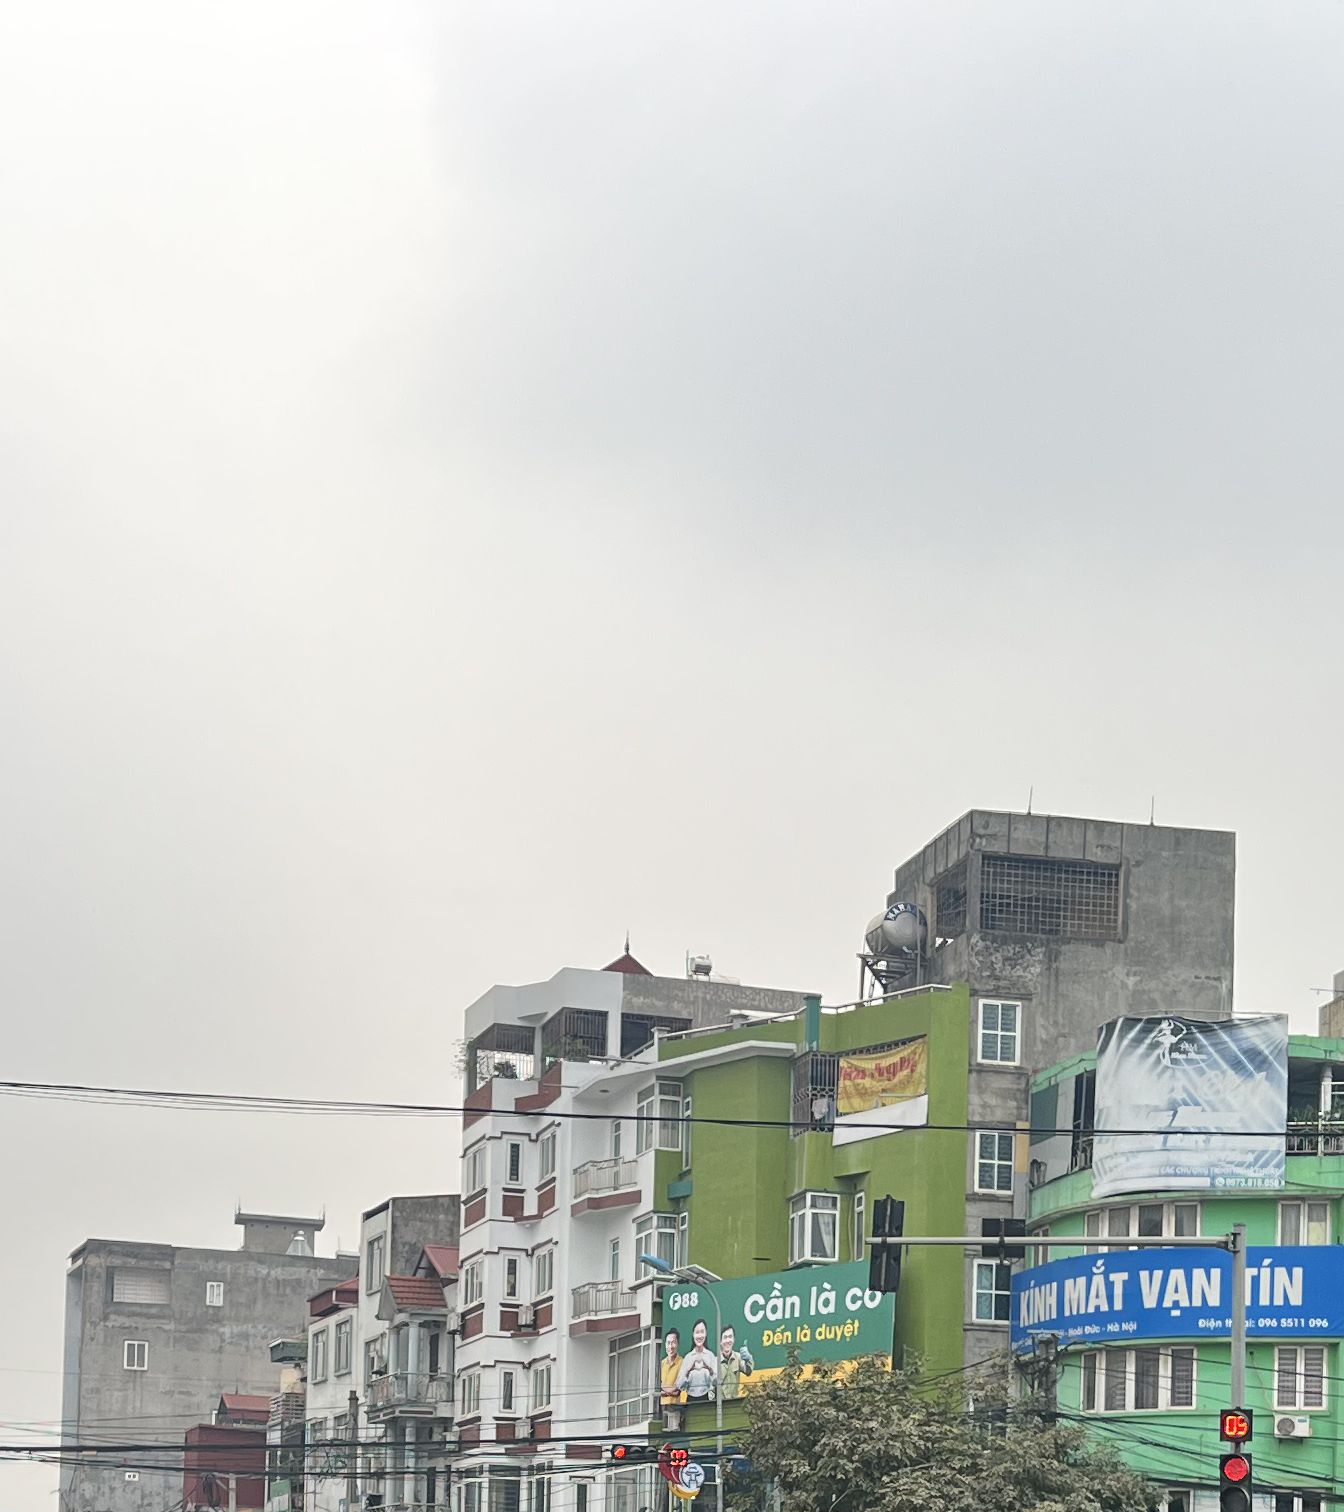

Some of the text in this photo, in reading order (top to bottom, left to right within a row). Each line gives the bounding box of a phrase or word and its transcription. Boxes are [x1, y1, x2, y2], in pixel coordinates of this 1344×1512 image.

[744, 1281, 800, 1323] Cần
[810, 1281, 837, 1316] là
[1020, 1258, 1303, 1328] KÍNH MẮT VẠN TÍN
[762, 1318, 860, 1347] Đến là duyệt
[1107, 1322, 1120, 1332] Hà
[1122, 1321, 1137, 1334] Nội
[1198, 1318, 1328, 1330] Điện 096 5511 096
[1226, 1415, 1249, 1436] 05
